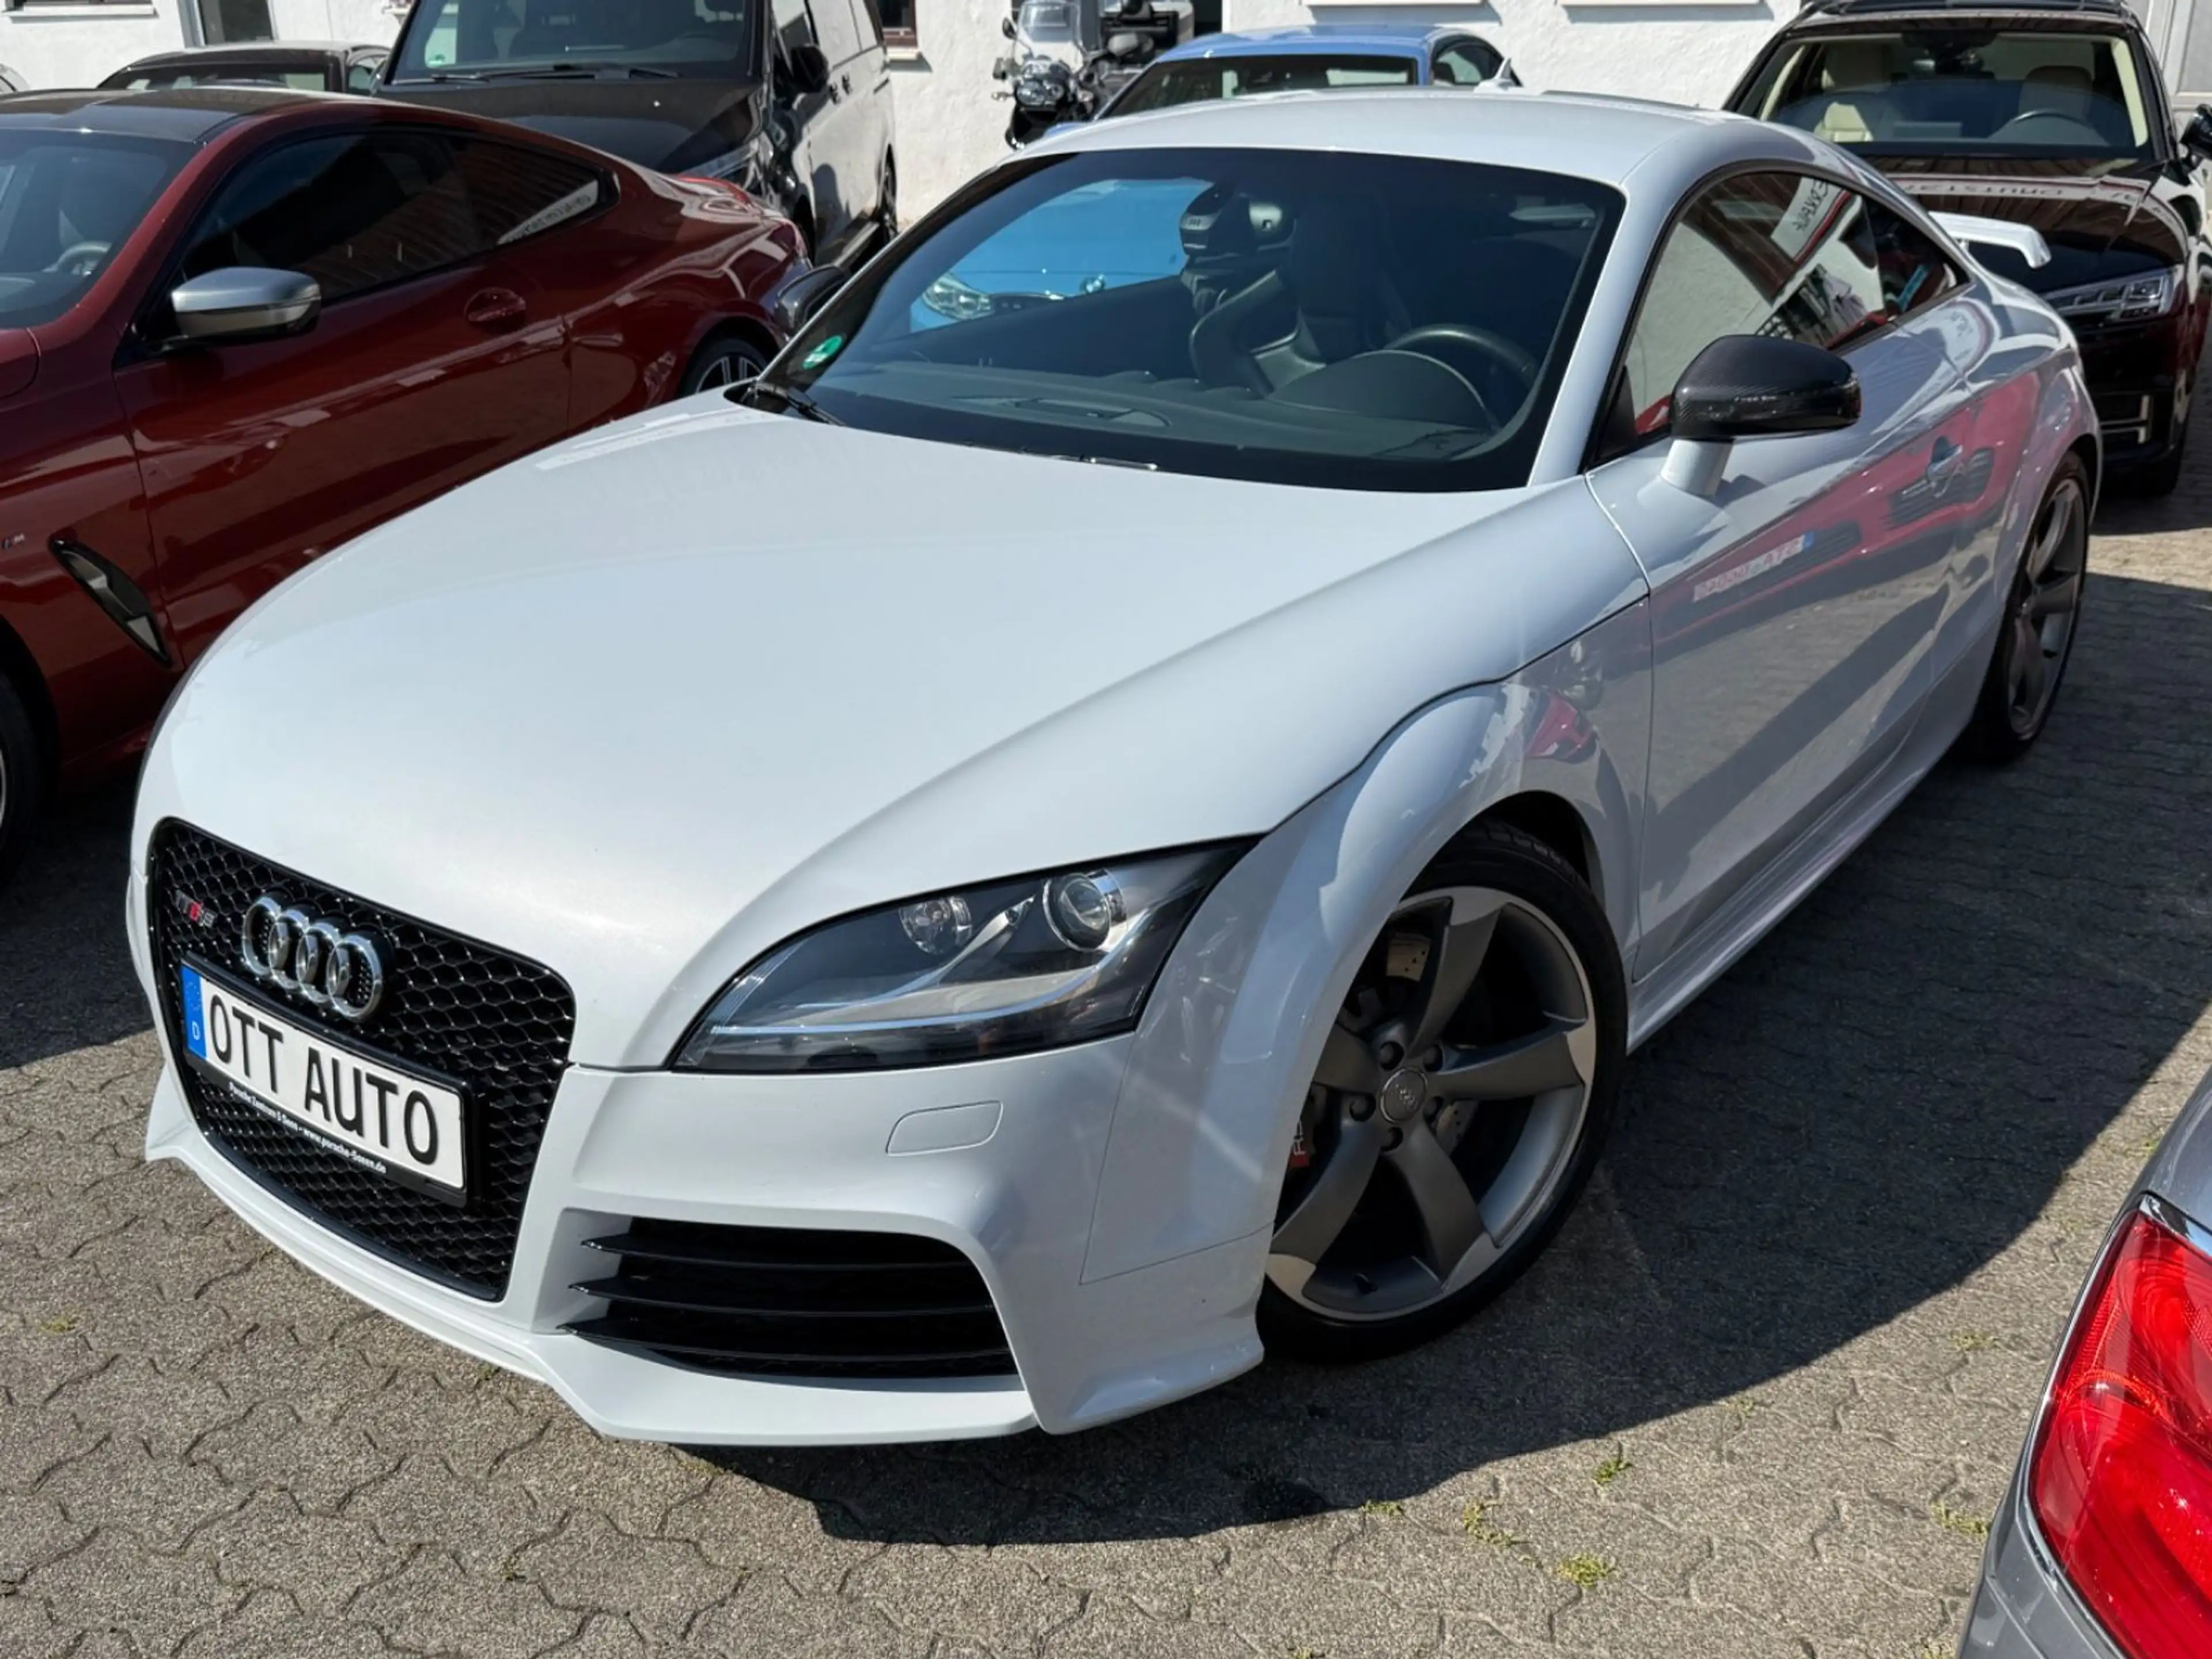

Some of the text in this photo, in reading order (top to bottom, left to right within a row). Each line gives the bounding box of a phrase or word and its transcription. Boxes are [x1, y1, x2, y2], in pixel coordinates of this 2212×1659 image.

[192, 1022, 200, 1040] D
[210, 994, 439, 1166] OTT AUTO
